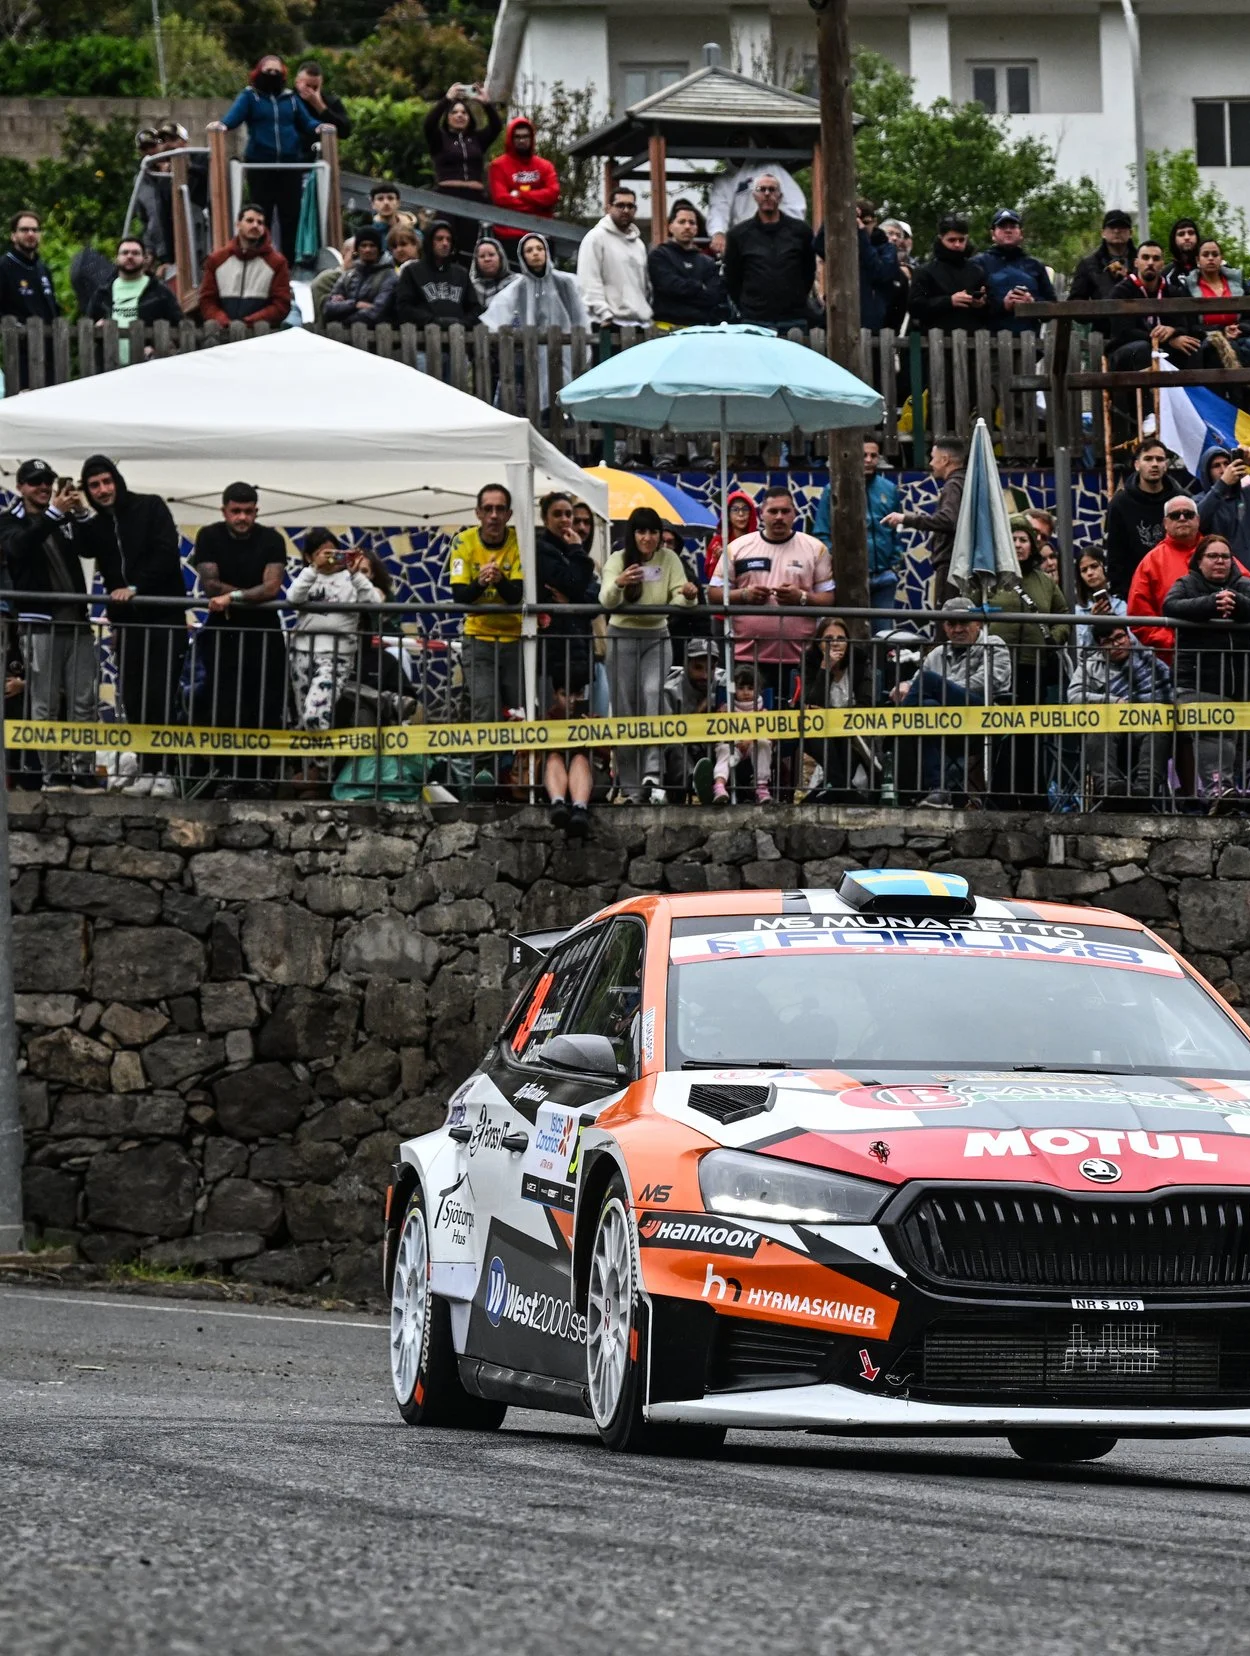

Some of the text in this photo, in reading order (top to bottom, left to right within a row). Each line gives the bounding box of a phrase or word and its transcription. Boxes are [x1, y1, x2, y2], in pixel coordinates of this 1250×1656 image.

[12, 726, 56, 744] ZONA
[61, 728, 132, 746] PUBLICO
[151, 730, 195, 748] ZONA
[200, 732, 270, 750] PUBLICO
[290, 734, 334, 750] ZONA
[339, 732, 408, 750] PUBLICO
[428, 729, 474, 747] ZONA
[478, 726, 548, 746] PUBLICO
[567, 724, 613, 742] ZONA
[618, 720, 688, 740] PUBLICO
[706, 718, 751, 735] ZONA
[756, 714, 824, 733] PUBLICO
[843, 713, 887, 730] ZONA
[892, 712, 962, 729] PUBLICO
[981, 712, 1026, 728] ZONA
[1030, 710, 1100, 728] PUBLICO
[1119, 709, 1162, 726] ZONA
[1166, 708, 1236, 725] PUBLICO
[753, 915, 1085, 939] MS MUNARETTO
[775, 930, 1144, 964] FORUM8
[963, 1128, 1219, 1162] MOTUL
[638, 1183, 673, 1203] MS
[442, 1200, 474, 1235] Sjötorps
[451, 1228, 466, 1246] Hus
[503, 1282, 588, 1345] West2000.se
[747, 1287, 876, 1326] HYRMASKINER
[1075, 1299, 1139, 1311] NR S 109
